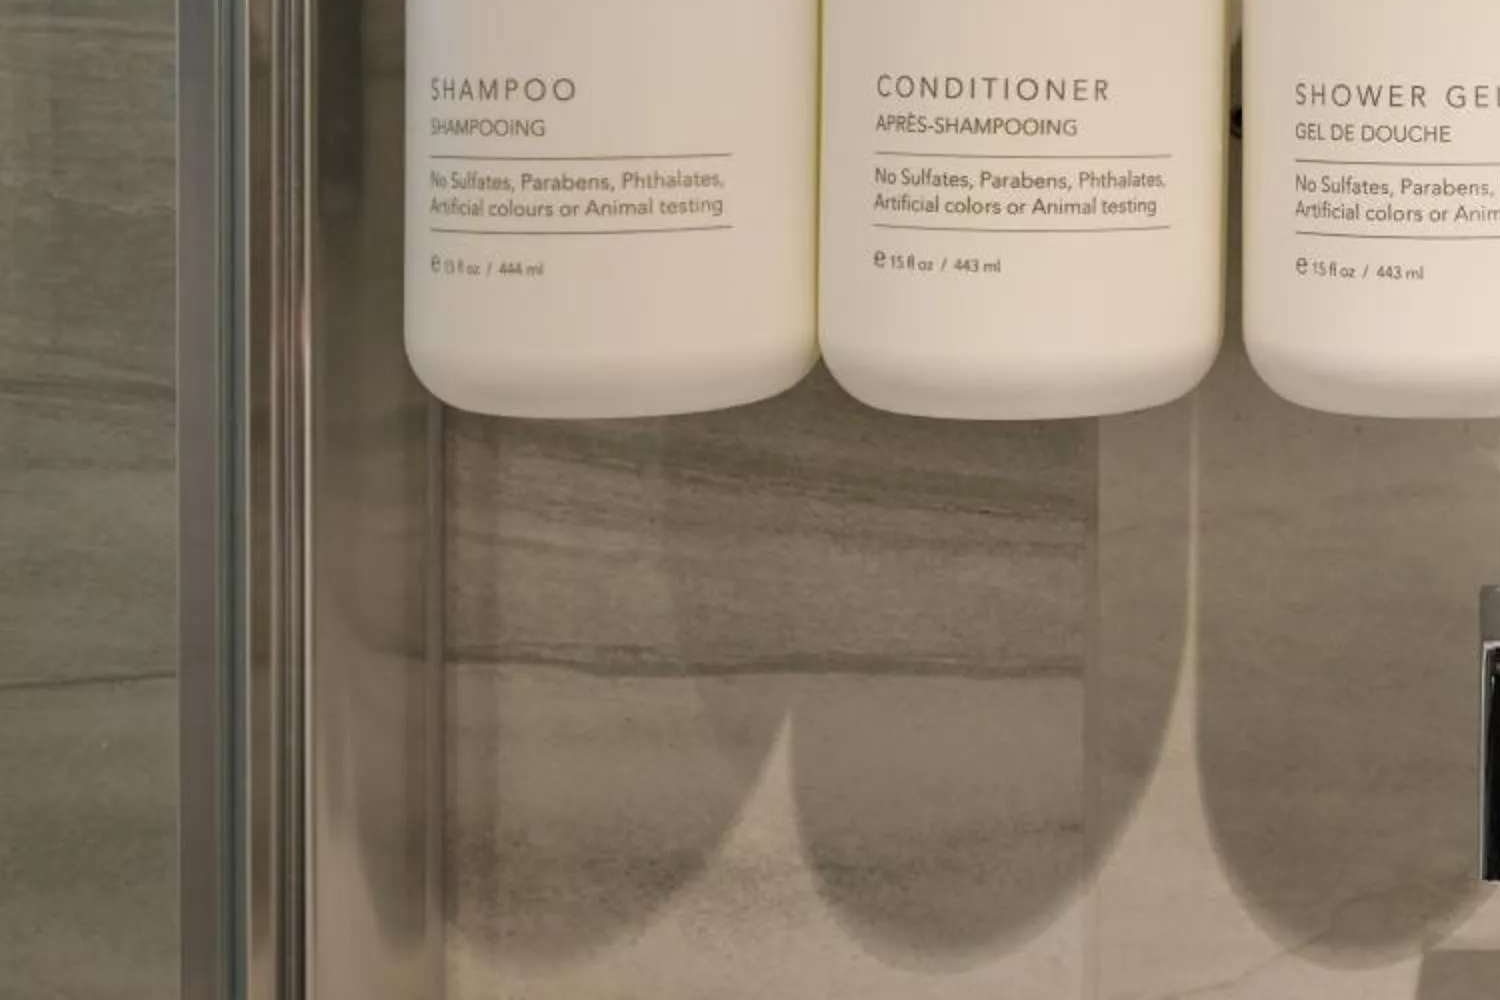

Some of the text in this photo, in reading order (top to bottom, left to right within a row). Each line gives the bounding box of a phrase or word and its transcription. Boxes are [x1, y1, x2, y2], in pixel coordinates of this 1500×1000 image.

[431, 77, 576, 102] SHAMPOO
[877, 74, 1109, 102] CONDITIONER
[1295, 83, 1426, 108] SHOWER
[431, 119, 546, 138] SHAMPOOING
[875, 112, 1078, 137] APRÈS-SHAMPOOING
[1295, 123, 1451, 143] GEL DE DOUCHE
[431, 171, 447, 189] No
[451, 171, 516, 194] Sulfates,
[521, 173, 616, 193] Parabens,
[875, 168, 897, 185] No
[901, 169, 974, 190] Sulfates,
[979, 171, 1072, 191] Parabens,
[1295, 176, 1317, 193] No
[1320, 176, 1394, 197] Sulfates,
[1400, 179, 1494, 197] Parabens,
[431, 197, 723, 217] Artificial colours or Animal testing
[874, 195, 1157, 217] Artificial colors or Animal testing
[1295, 201, 1360, 220] Artificial
[1365, 204, 1423, 222] colors
[1429, 209, 1448, 222] or
[918, 260, 933, 271] oz
[954, 258, 979, 273] 443
[984, 260, 1001, 273] ml
[1313, 260, 1327, 276] 15
[1340, 265, 1355, 278] oz
[1376, 265, 1402, 280] 443
[1406, 265, 1424, 281] ml
